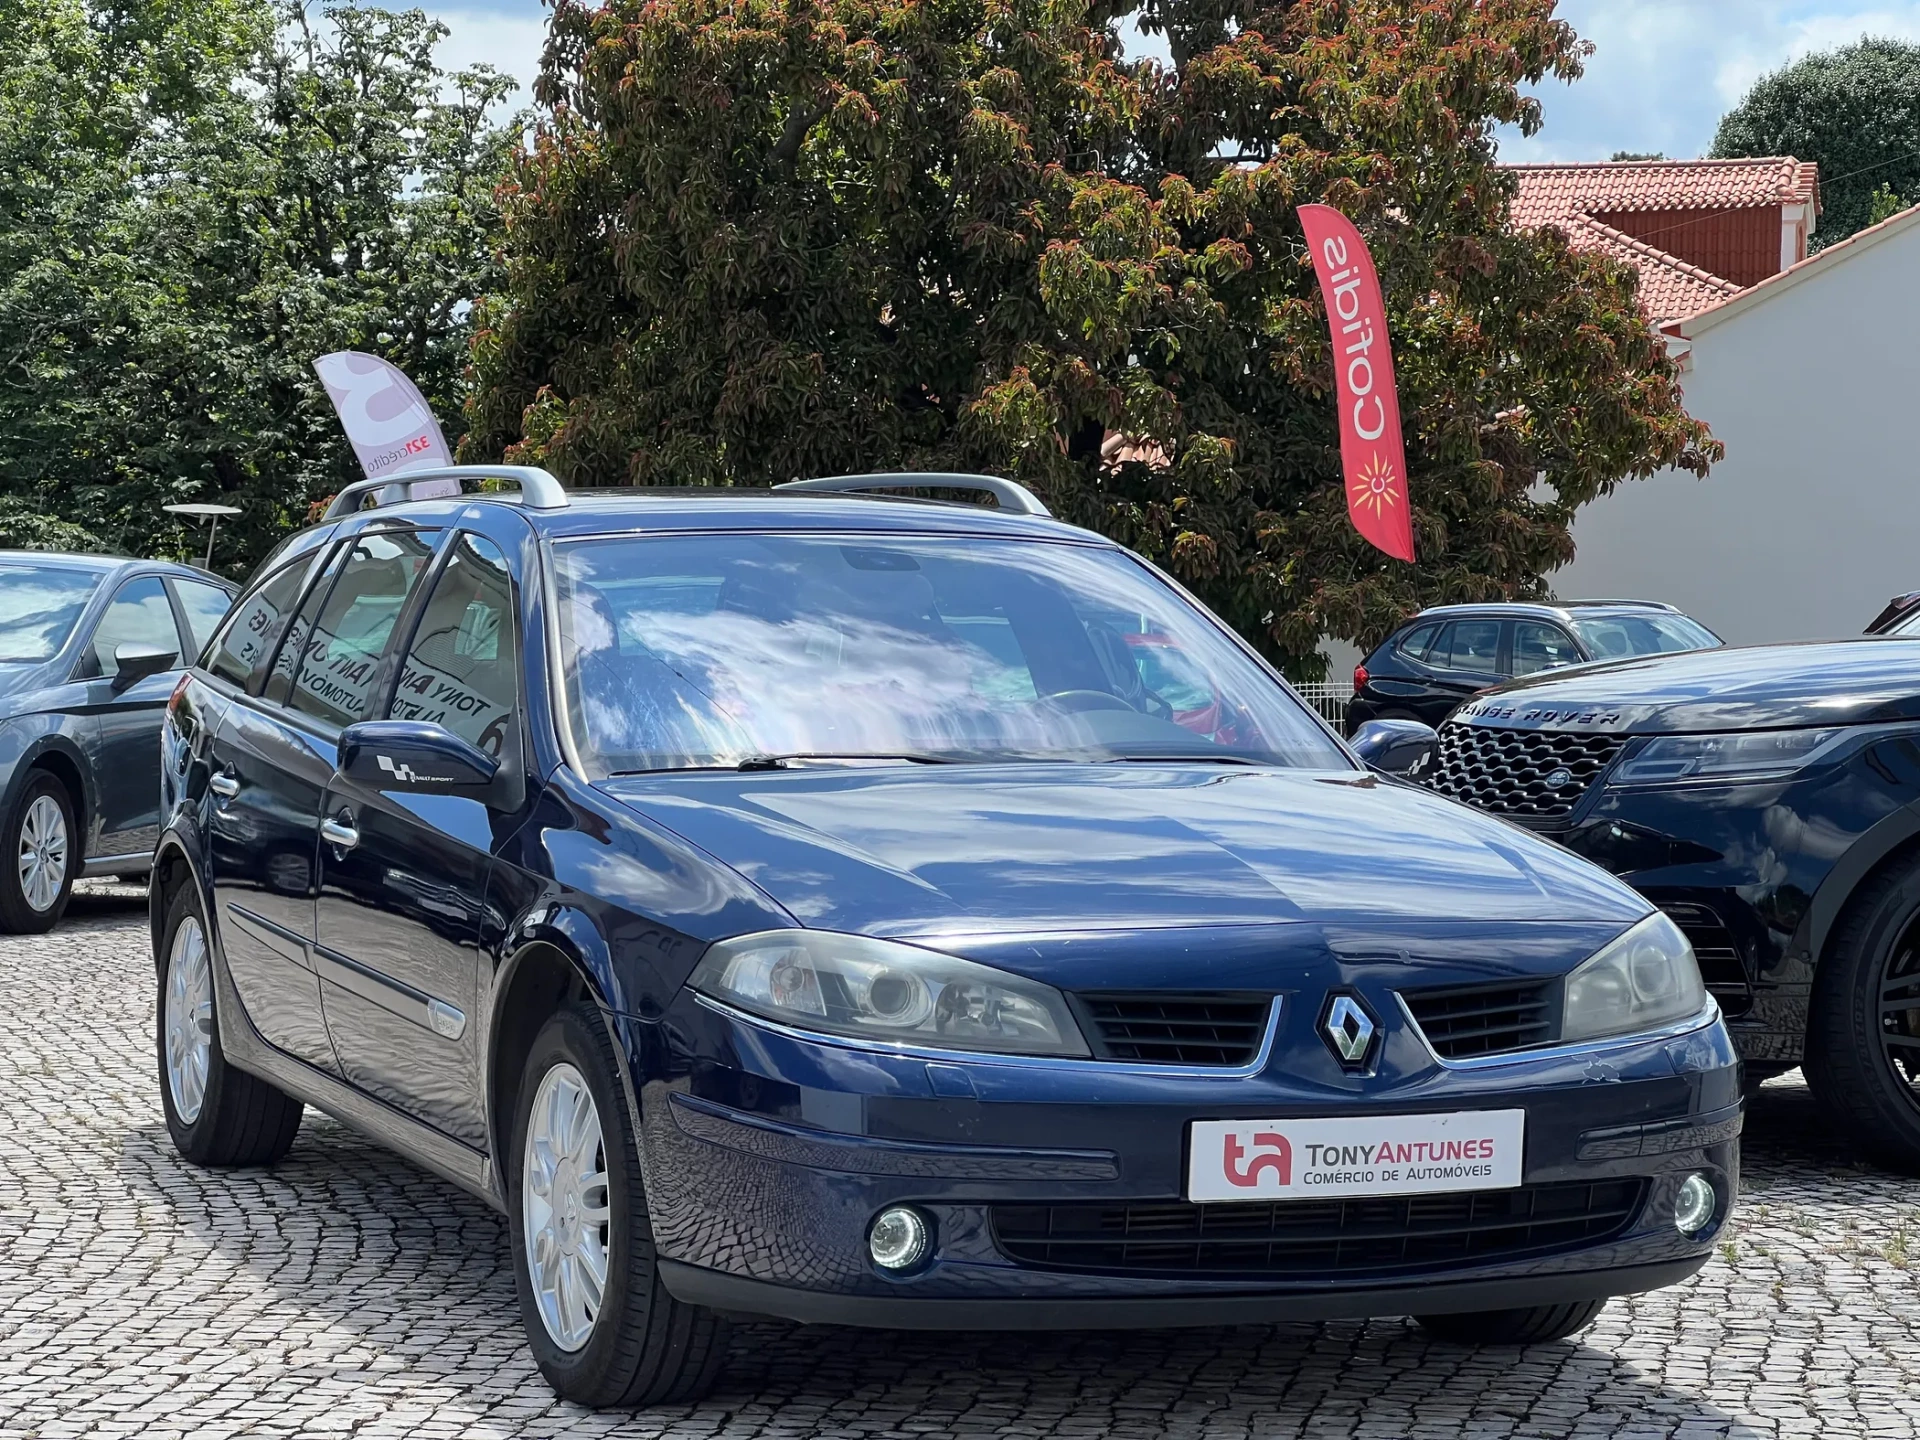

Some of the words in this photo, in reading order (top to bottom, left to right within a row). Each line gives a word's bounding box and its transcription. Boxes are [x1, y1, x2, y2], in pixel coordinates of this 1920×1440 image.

[1456, 703, 1516, 719] RANGE
[1523, 708, 1621, 725] ROVER
[1381, 1169, 1399, 1182] DE
